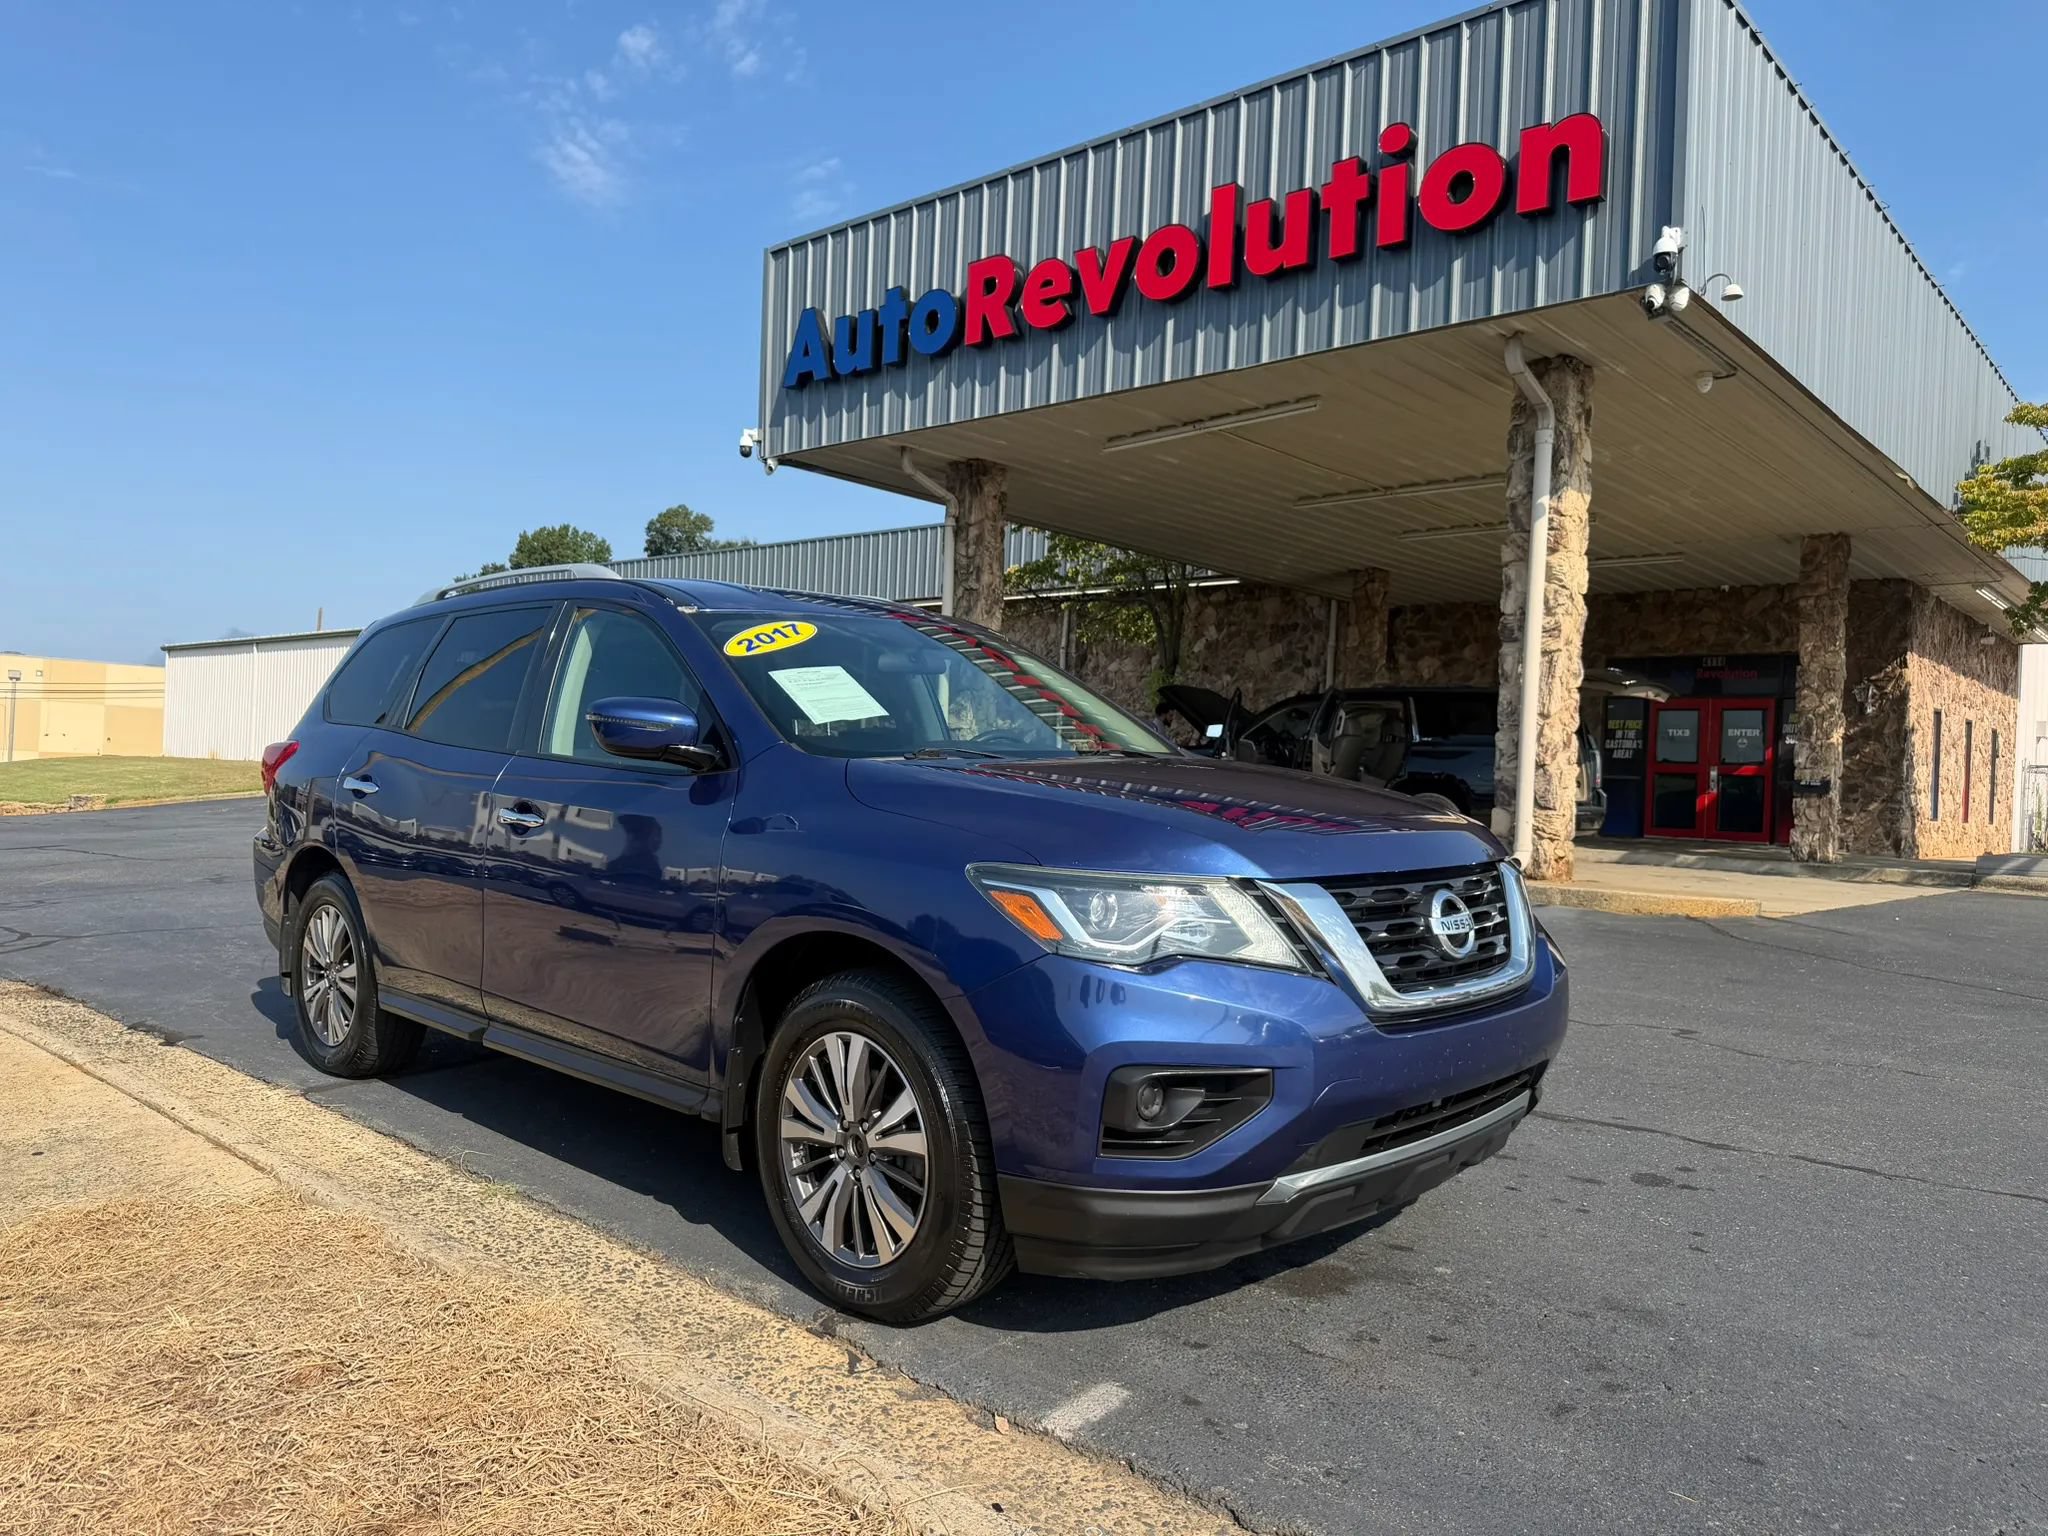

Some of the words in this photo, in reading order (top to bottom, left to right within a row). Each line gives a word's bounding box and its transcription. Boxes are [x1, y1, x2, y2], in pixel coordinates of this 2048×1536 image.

[783, 112, 1606, 390] AutoRevolution
[737, 623, 802, 653] 2017
[1607, 719, 1625, 730] BEST
[1625, 719, 1643, 730] PRICE
[1615, 730, 1624, 739] IN
[1624, 730, 1637, 739] THE
[1727, 728, 1761, 737] ENTER
